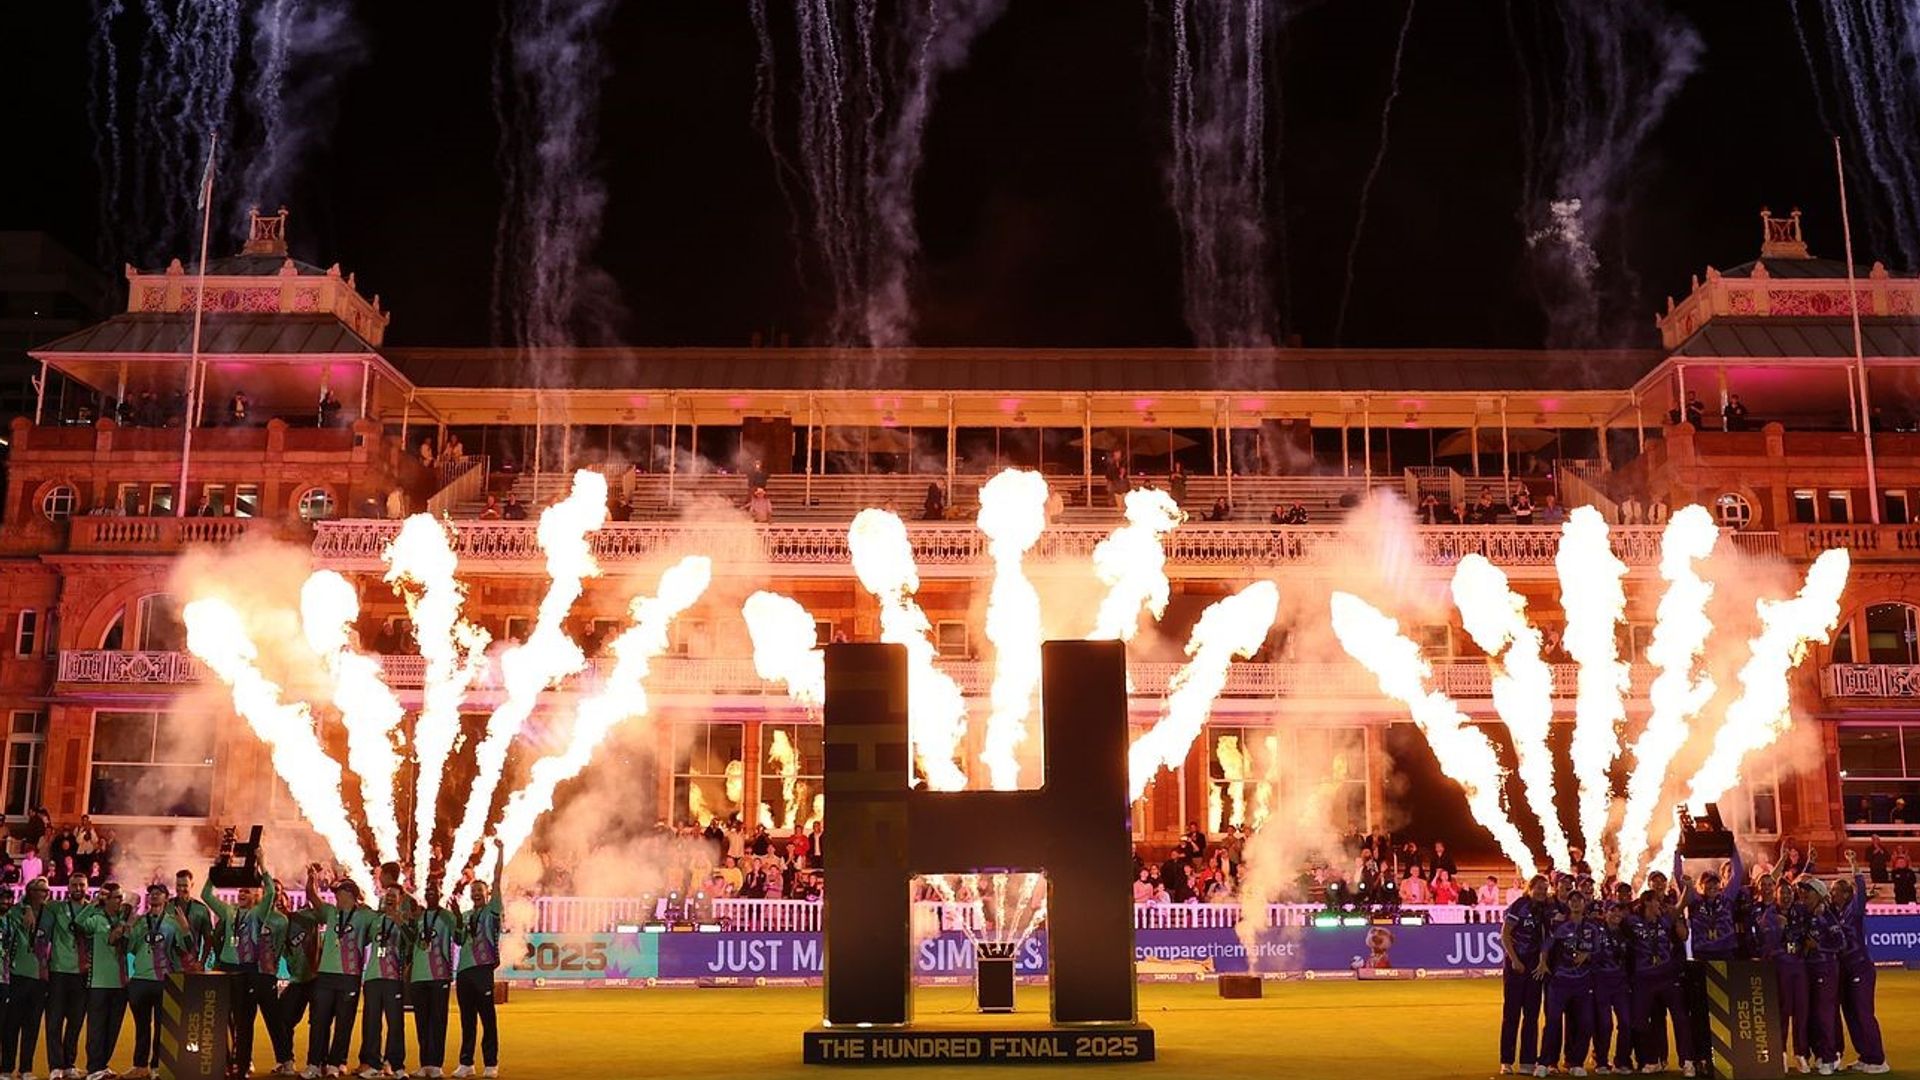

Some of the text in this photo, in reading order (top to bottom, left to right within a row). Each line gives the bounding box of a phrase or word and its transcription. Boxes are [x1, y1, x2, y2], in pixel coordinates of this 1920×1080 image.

[513, 942, 608, 971] 2025
[708, 938, 1044, 972] JUST M SIMS
[1136, 941, 1294, 960] comparethemarket
[1447, 932, 1503, 964] JUS
[1871, 932, 1920, 948] comp
[186, 1012, 200, 1053] 2025
[201, 990, 216, 1075] CHAMPIONS
[1737, 1001, 1751, 1040] 2025
[1751, 976, 1769, 1063] CHAMPIONS
[818, 1037, 1138, 1058] THE HUNDRED FINAL 2025
